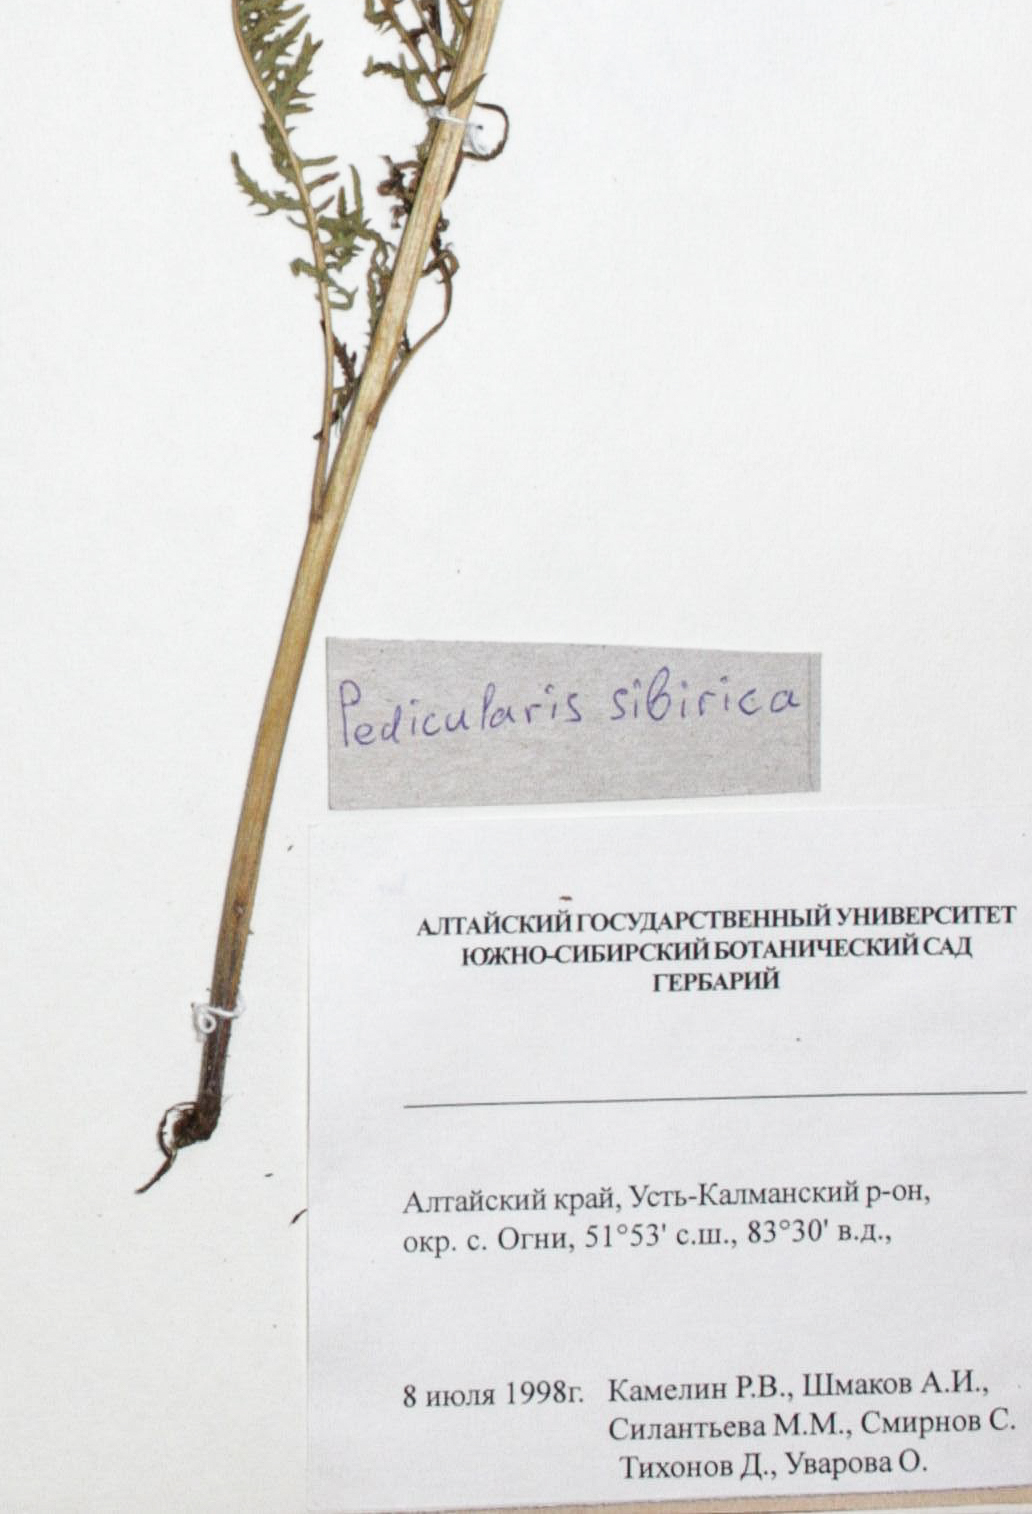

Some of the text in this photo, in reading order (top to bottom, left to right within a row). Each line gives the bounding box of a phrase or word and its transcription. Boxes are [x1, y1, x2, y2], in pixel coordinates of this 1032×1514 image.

[339, 666, 800, 747] Pedicularis sibirica
[417, 903, 1017, 936] АЛТАЙСКИЙ ГОСУДАРСТВЕННЫЙ УНИВЕРСИТЕТ
[462, 934, 973, 967] ЮЖНО-СИБИРСКИЙ БОТАНИЧЕСКИЙ САД
[653, 966, 780, 993] ГЕРБАРИЙ
[402, 1180, 931, 1217] Алтайский край, Усть-Калманский р-он,
[403, 1235, 456, 1259] окр.
[467, 1234, 487, 1251] с.
[497, 1227, 575, 1251] Огни,
[676, 1228, 737, 1247] с.ш.,
[838, 1223, 892, 1243] в.д.,
[403, 1369, 989, 1408] 8 июля 1998г. Камелин Р.В., Шмаков А.И.,
[608, 1406, 1016, 1441] Силантьева М.М., Смирнов С.
[619, 1448, 928, 1481] Тихонов Д., Уварова О.
